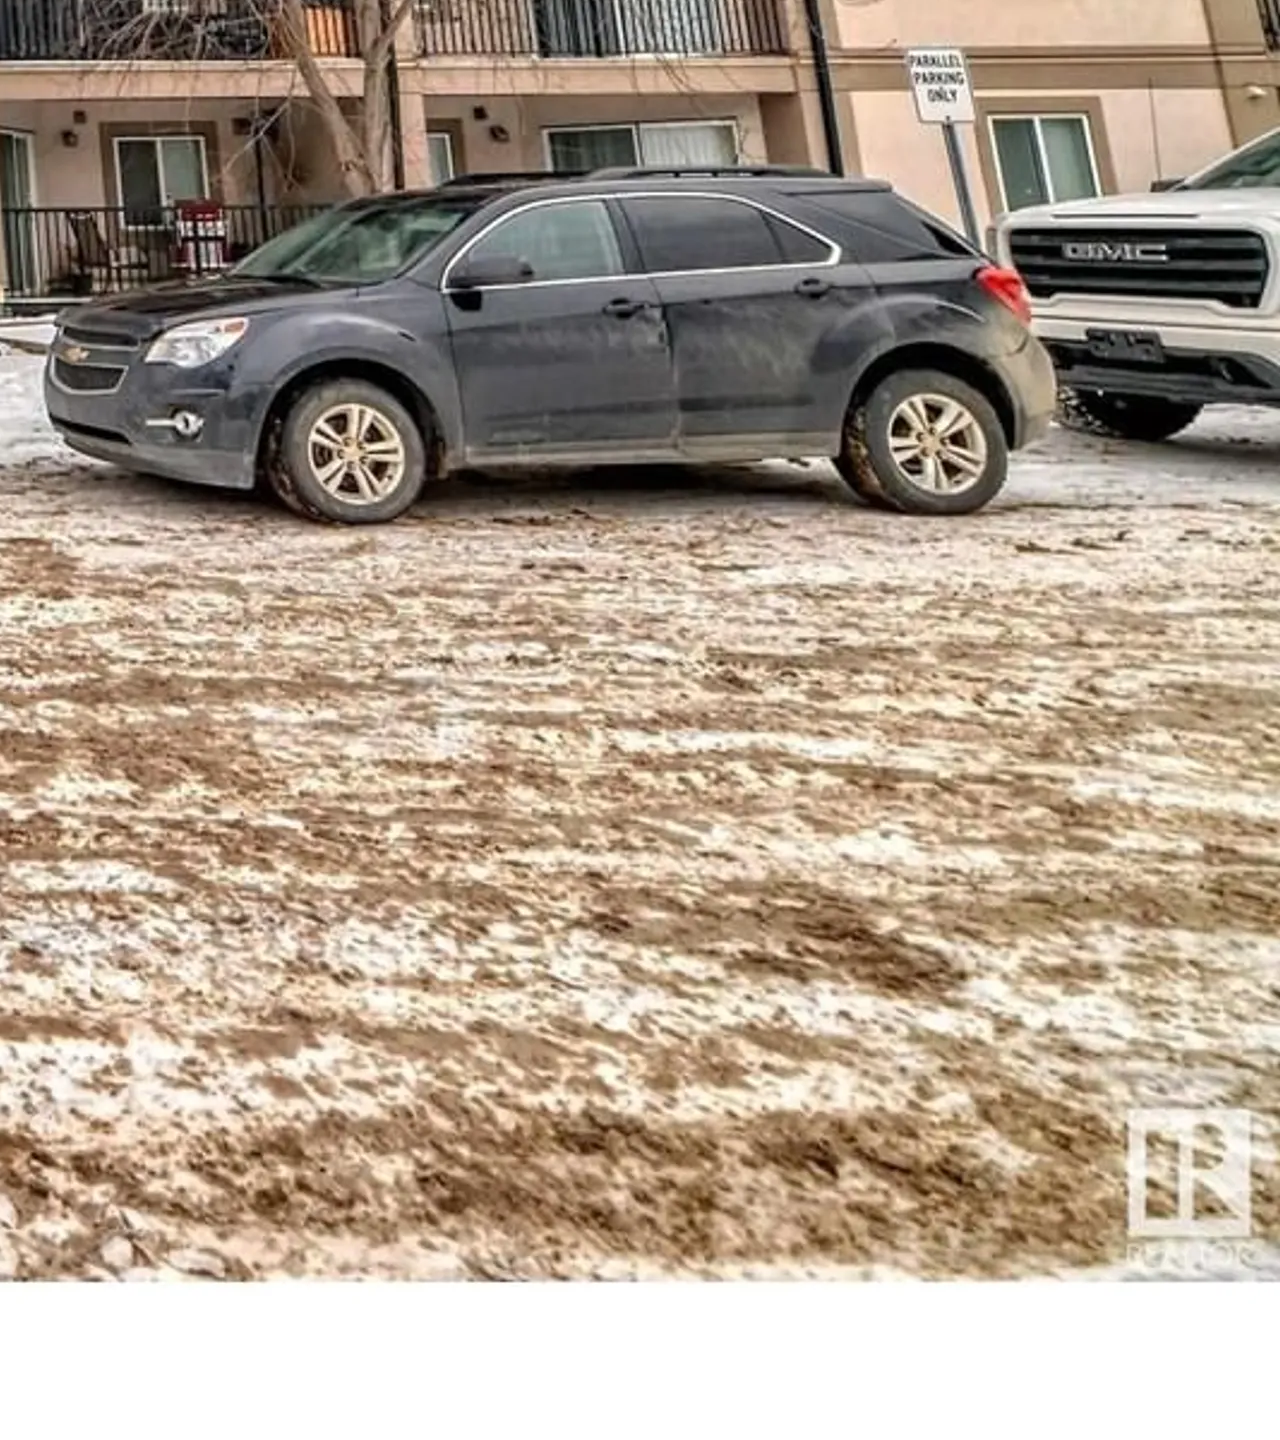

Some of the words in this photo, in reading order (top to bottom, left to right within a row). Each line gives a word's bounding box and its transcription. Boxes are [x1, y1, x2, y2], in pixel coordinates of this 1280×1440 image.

[909, 54, 961, 68] PARALLEL
[914, 71, 964, 85] PARKING
[927, 88, 957, 103] ONLY
[1061, 242, 1168, 261] GMC
